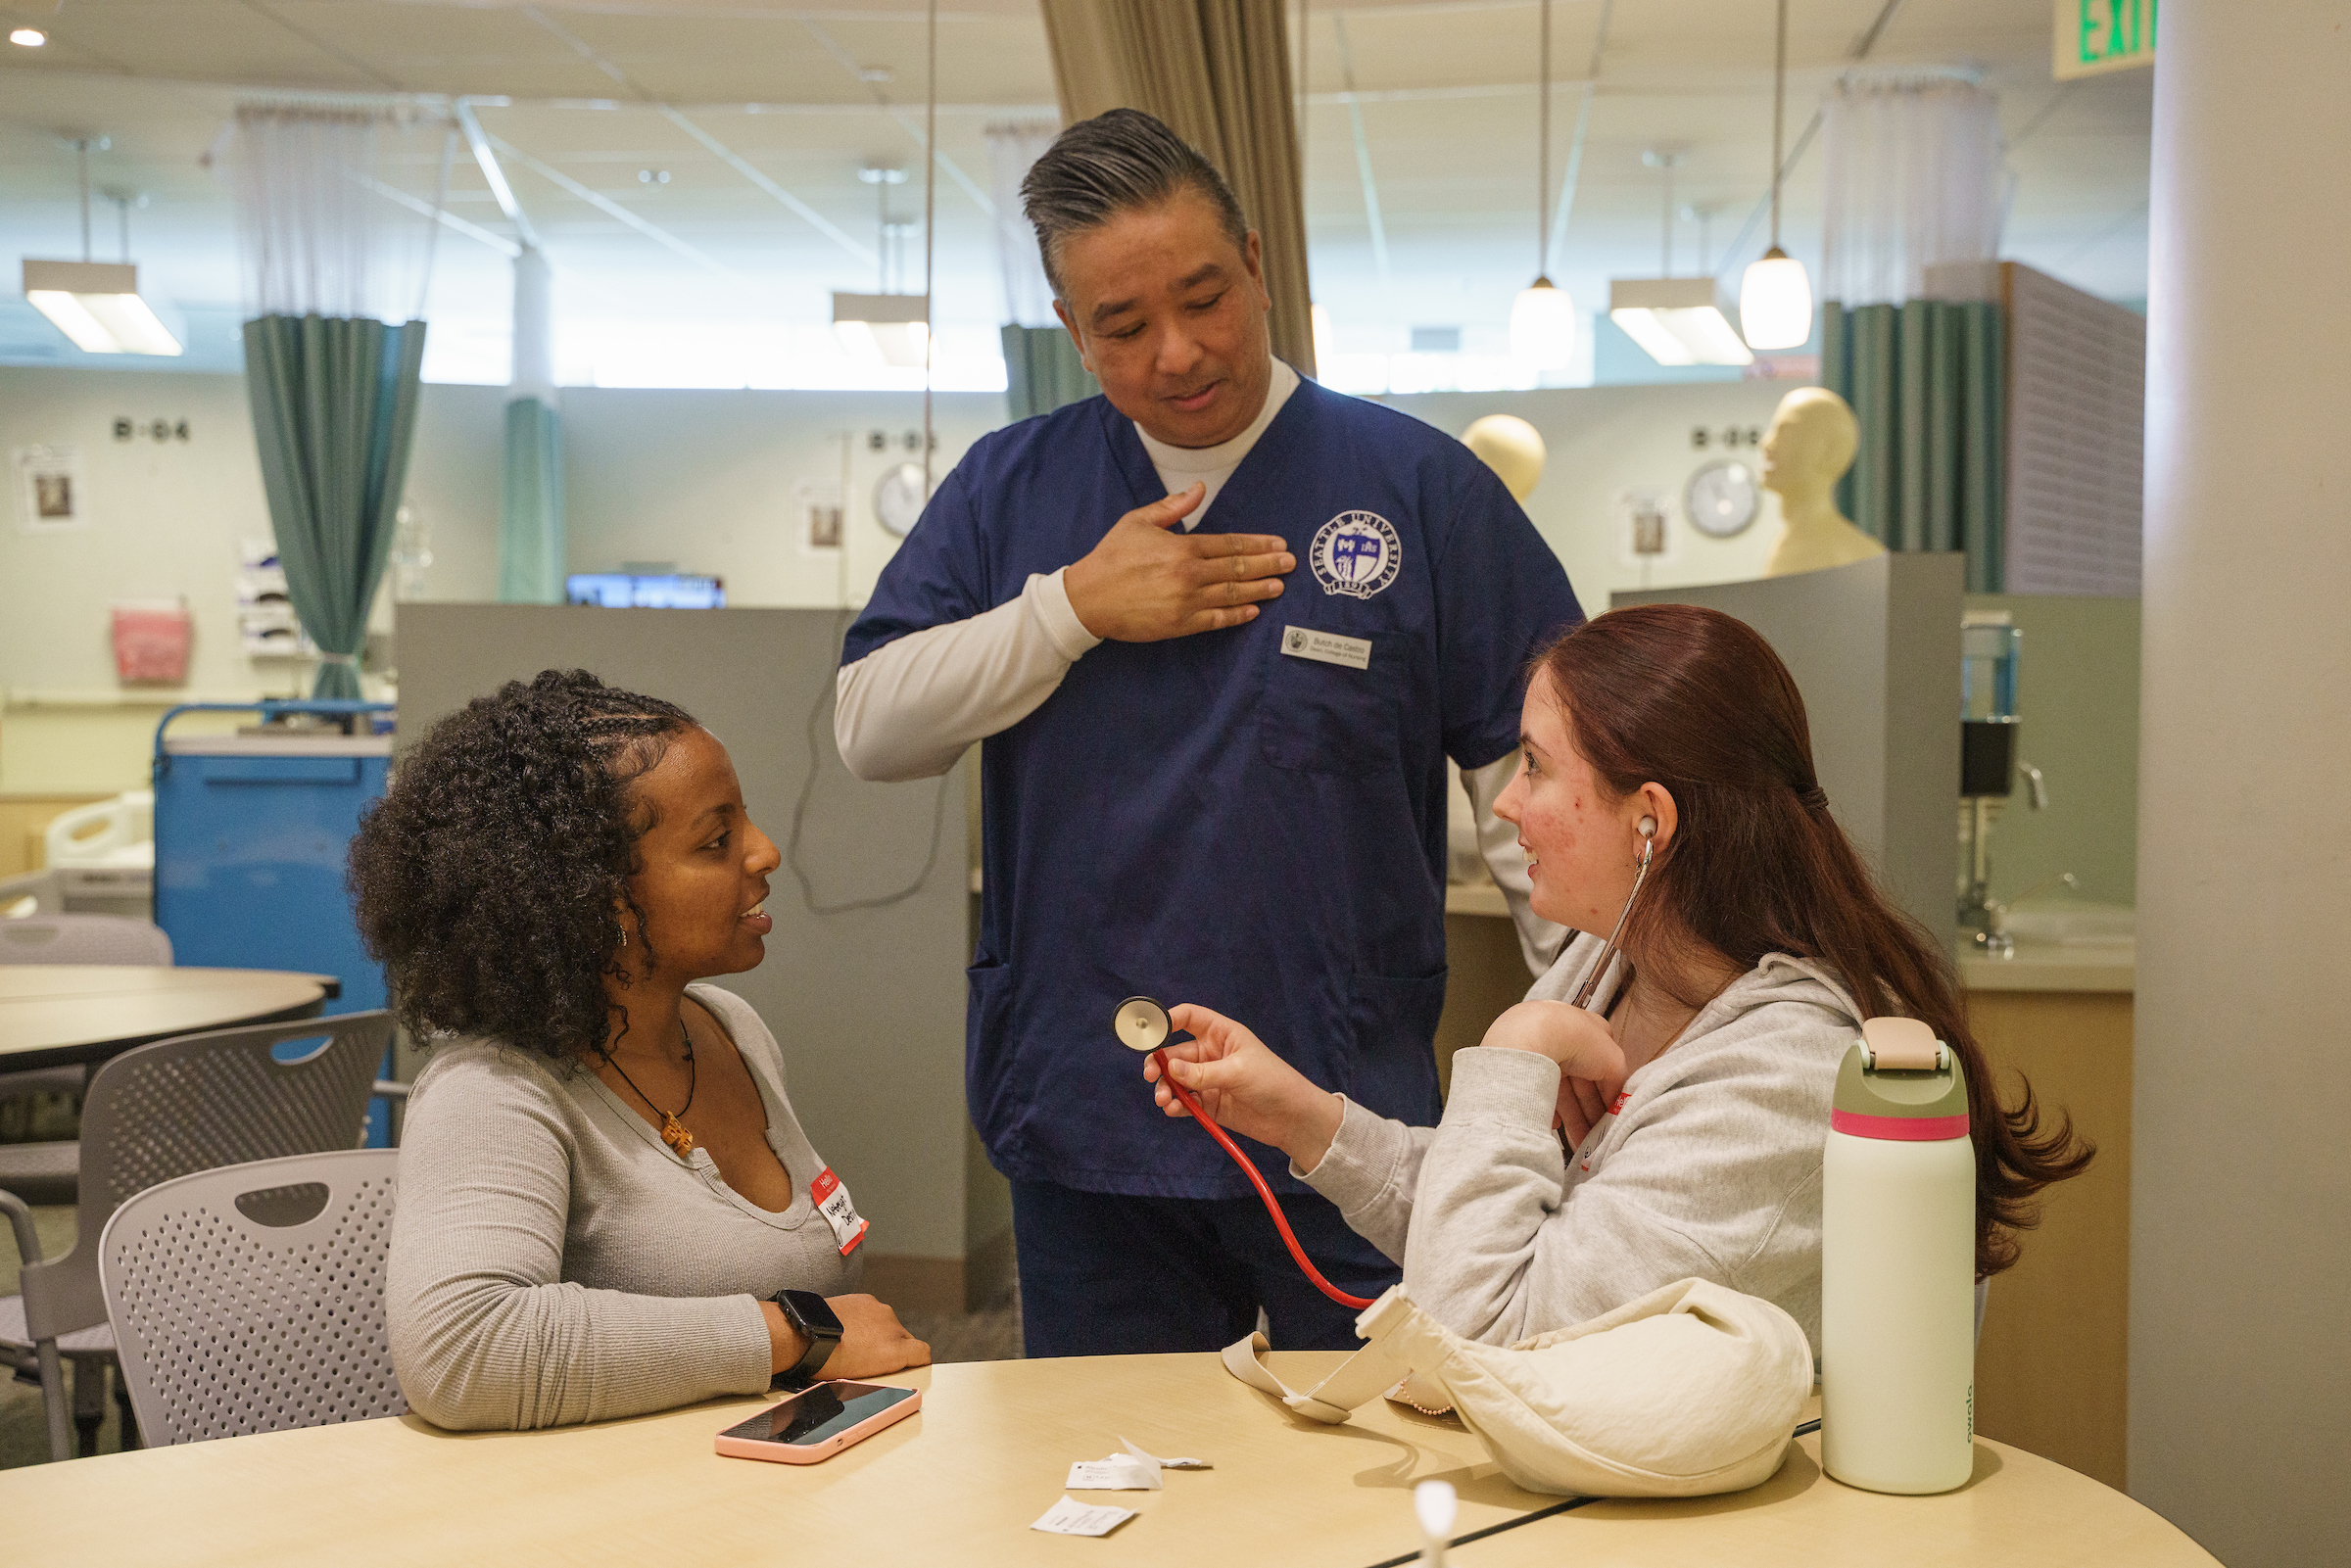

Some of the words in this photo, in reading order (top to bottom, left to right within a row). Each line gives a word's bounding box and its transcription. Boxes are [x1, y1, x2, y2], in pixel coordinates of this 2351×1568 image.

[1313, 517, 1346, 576] SEATTLE
[1351, 512, 1398, 587] UNIVERSITY
[819, 1174, 833, 1189] Hello
